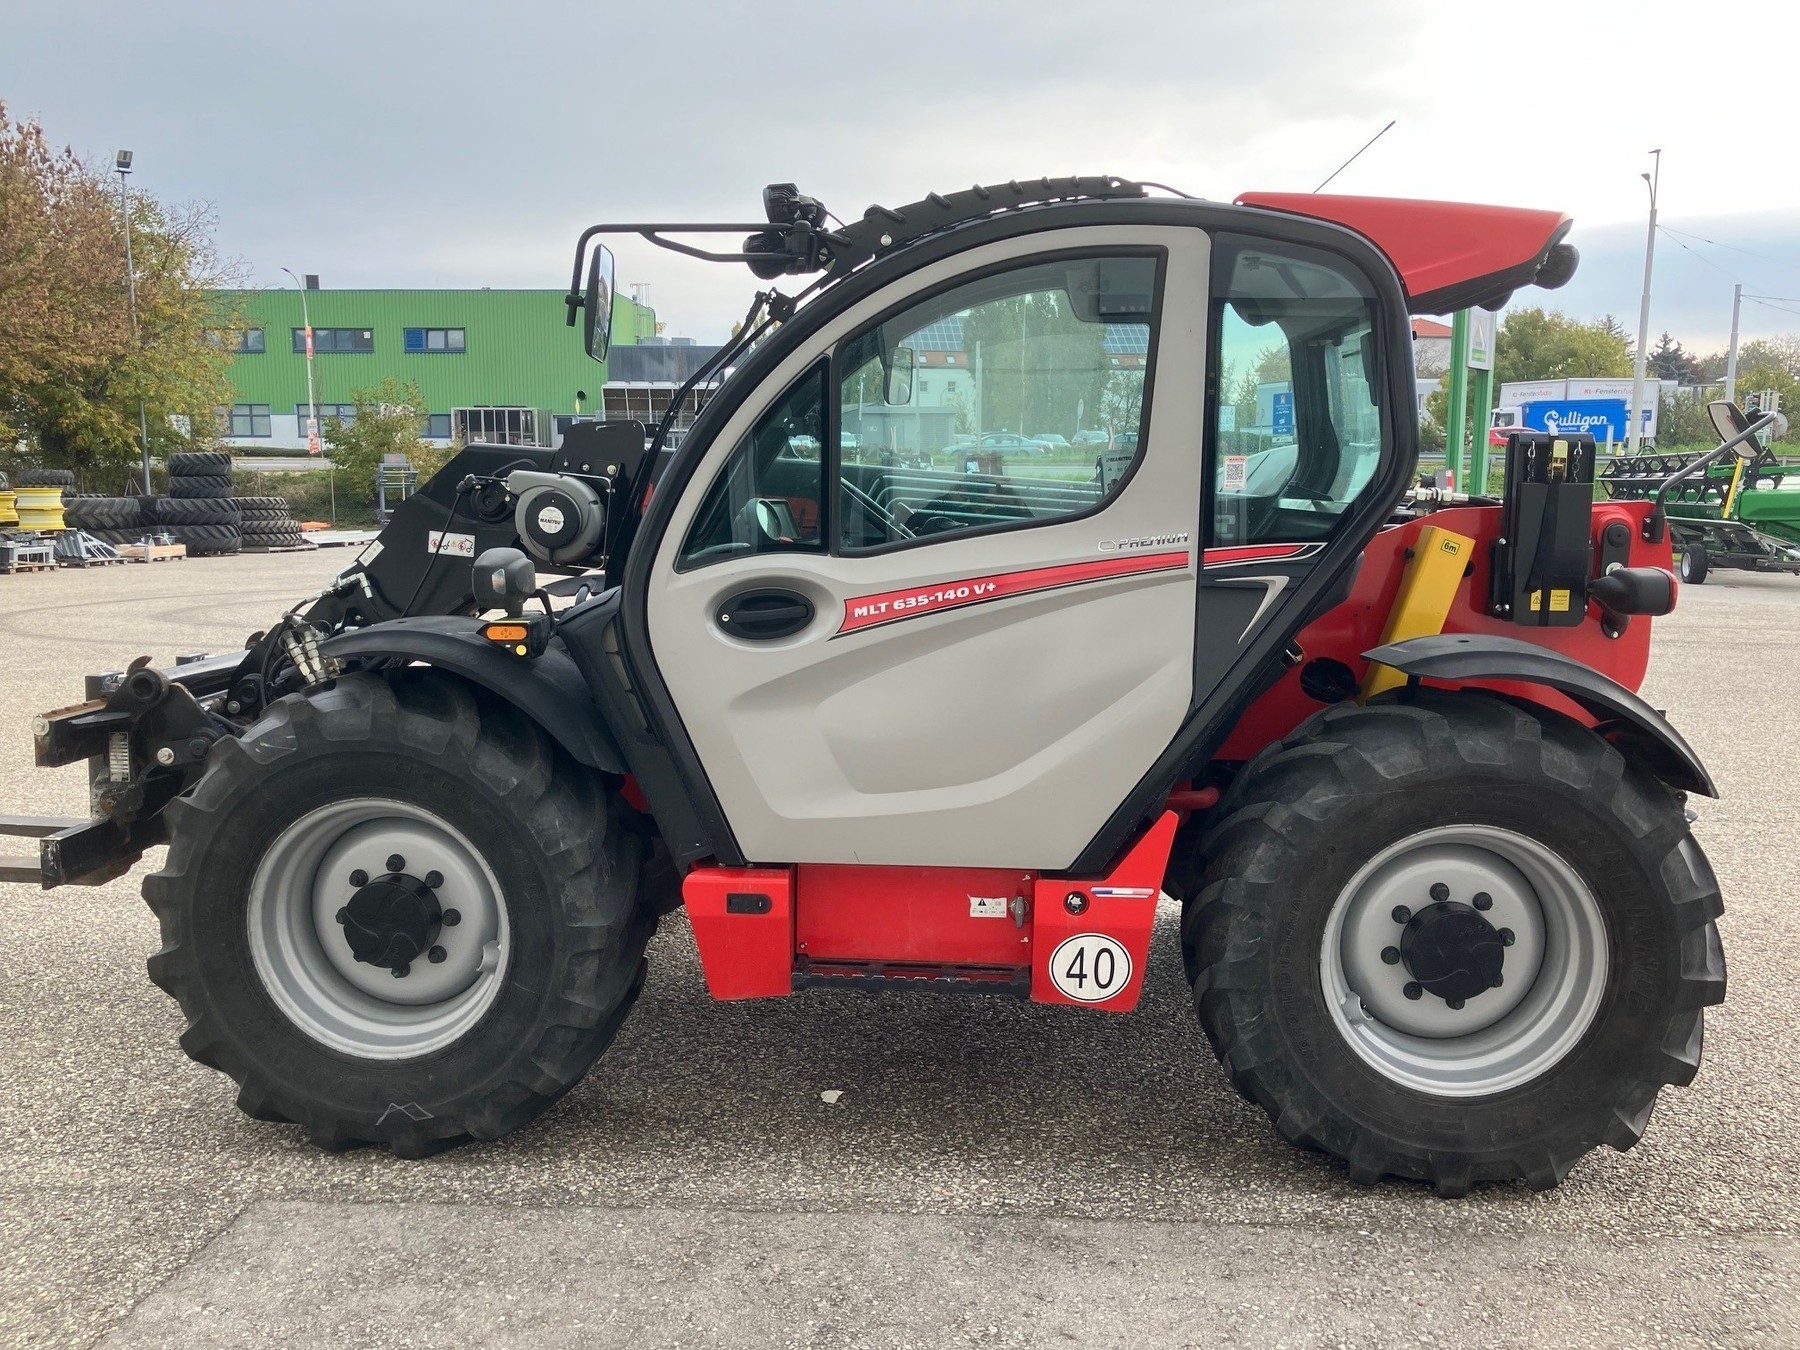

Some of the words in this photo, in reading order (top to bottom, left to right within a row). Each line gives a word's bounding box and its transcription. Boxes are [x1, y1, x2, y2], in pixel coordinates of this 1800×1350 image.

[1544, 410, 1607, 432] Culligan
[1119, 532, 1189, 549] PREMIUM
[1444, 542, 1457, 552] 6m
[854, 602, 889, 618] MLT
[893, 586, 970, 611] 635-140
[973, 582, 996, 595] V+
[1065, 946, 1115, 990] 40
